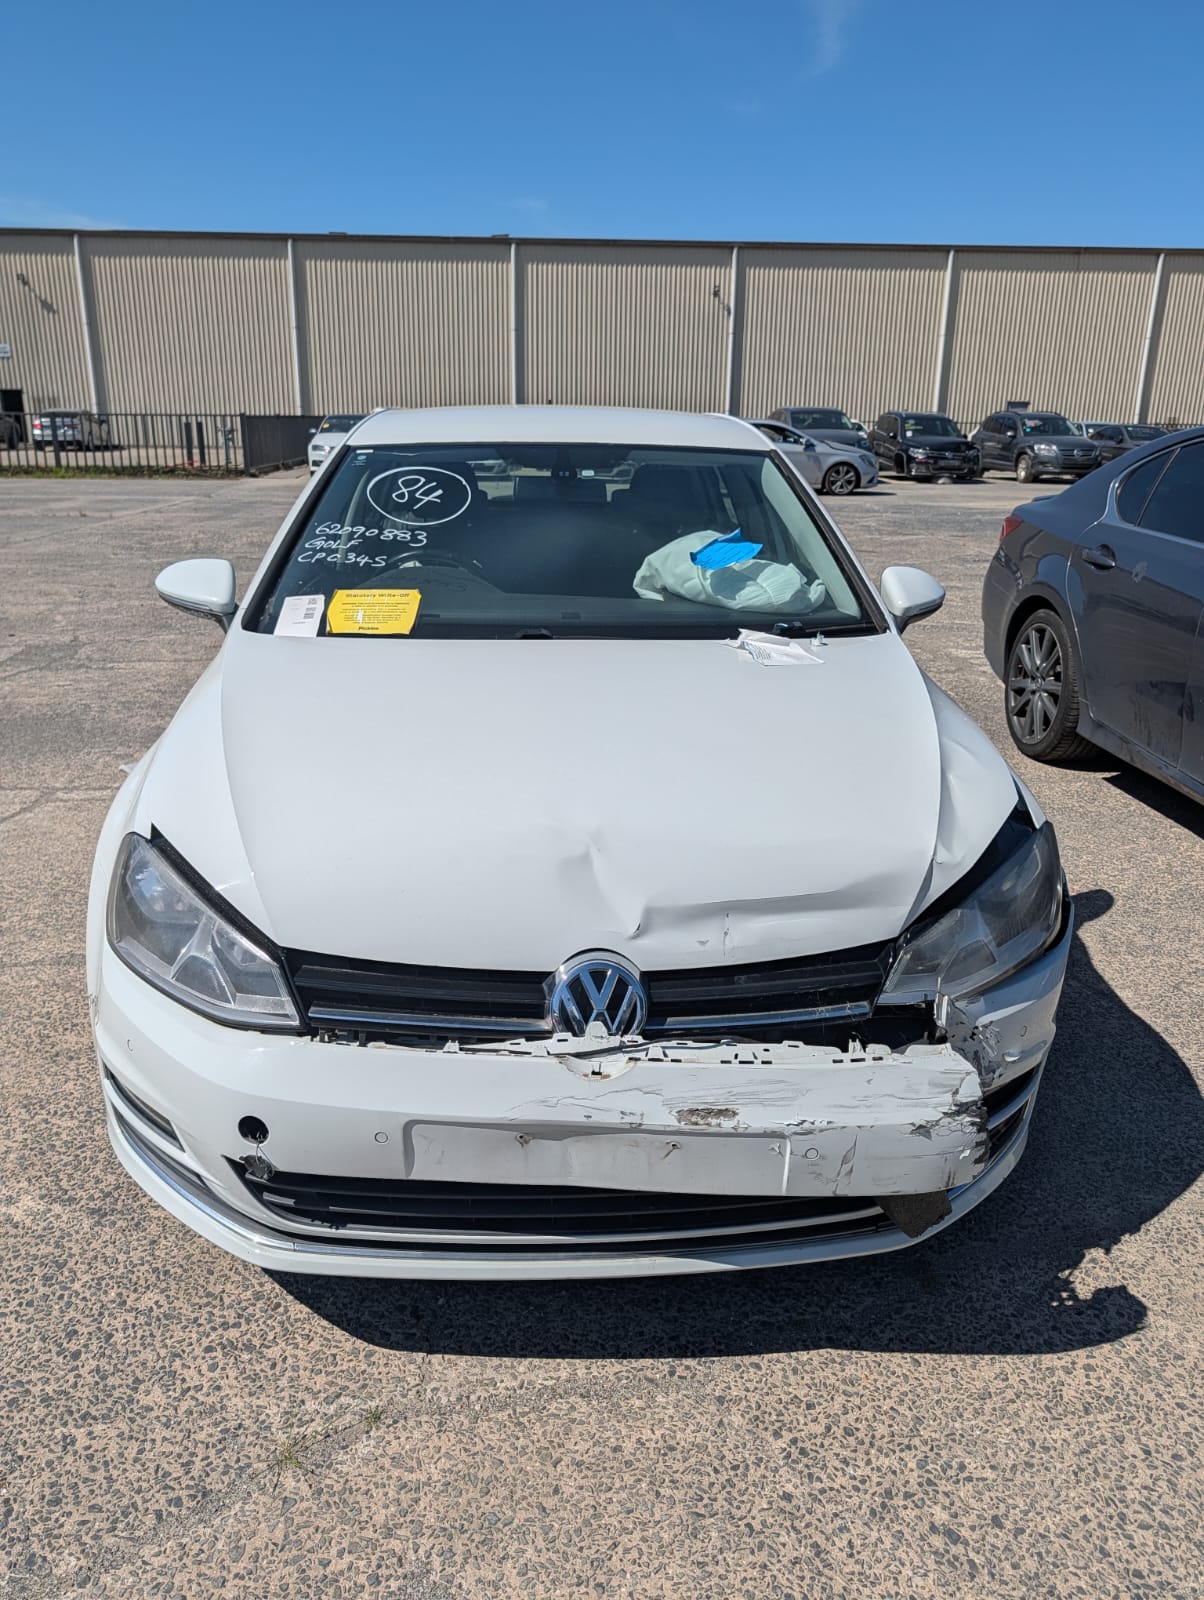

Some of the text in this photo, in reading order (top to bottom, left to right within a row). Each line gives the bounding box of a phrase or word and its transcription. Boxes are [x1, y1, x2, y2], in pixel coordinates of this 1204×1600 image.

[392, 475, 443, 509] 84
[304, 536, 364, 550] GOLF
[315, 521, 428, 546] 62090883
